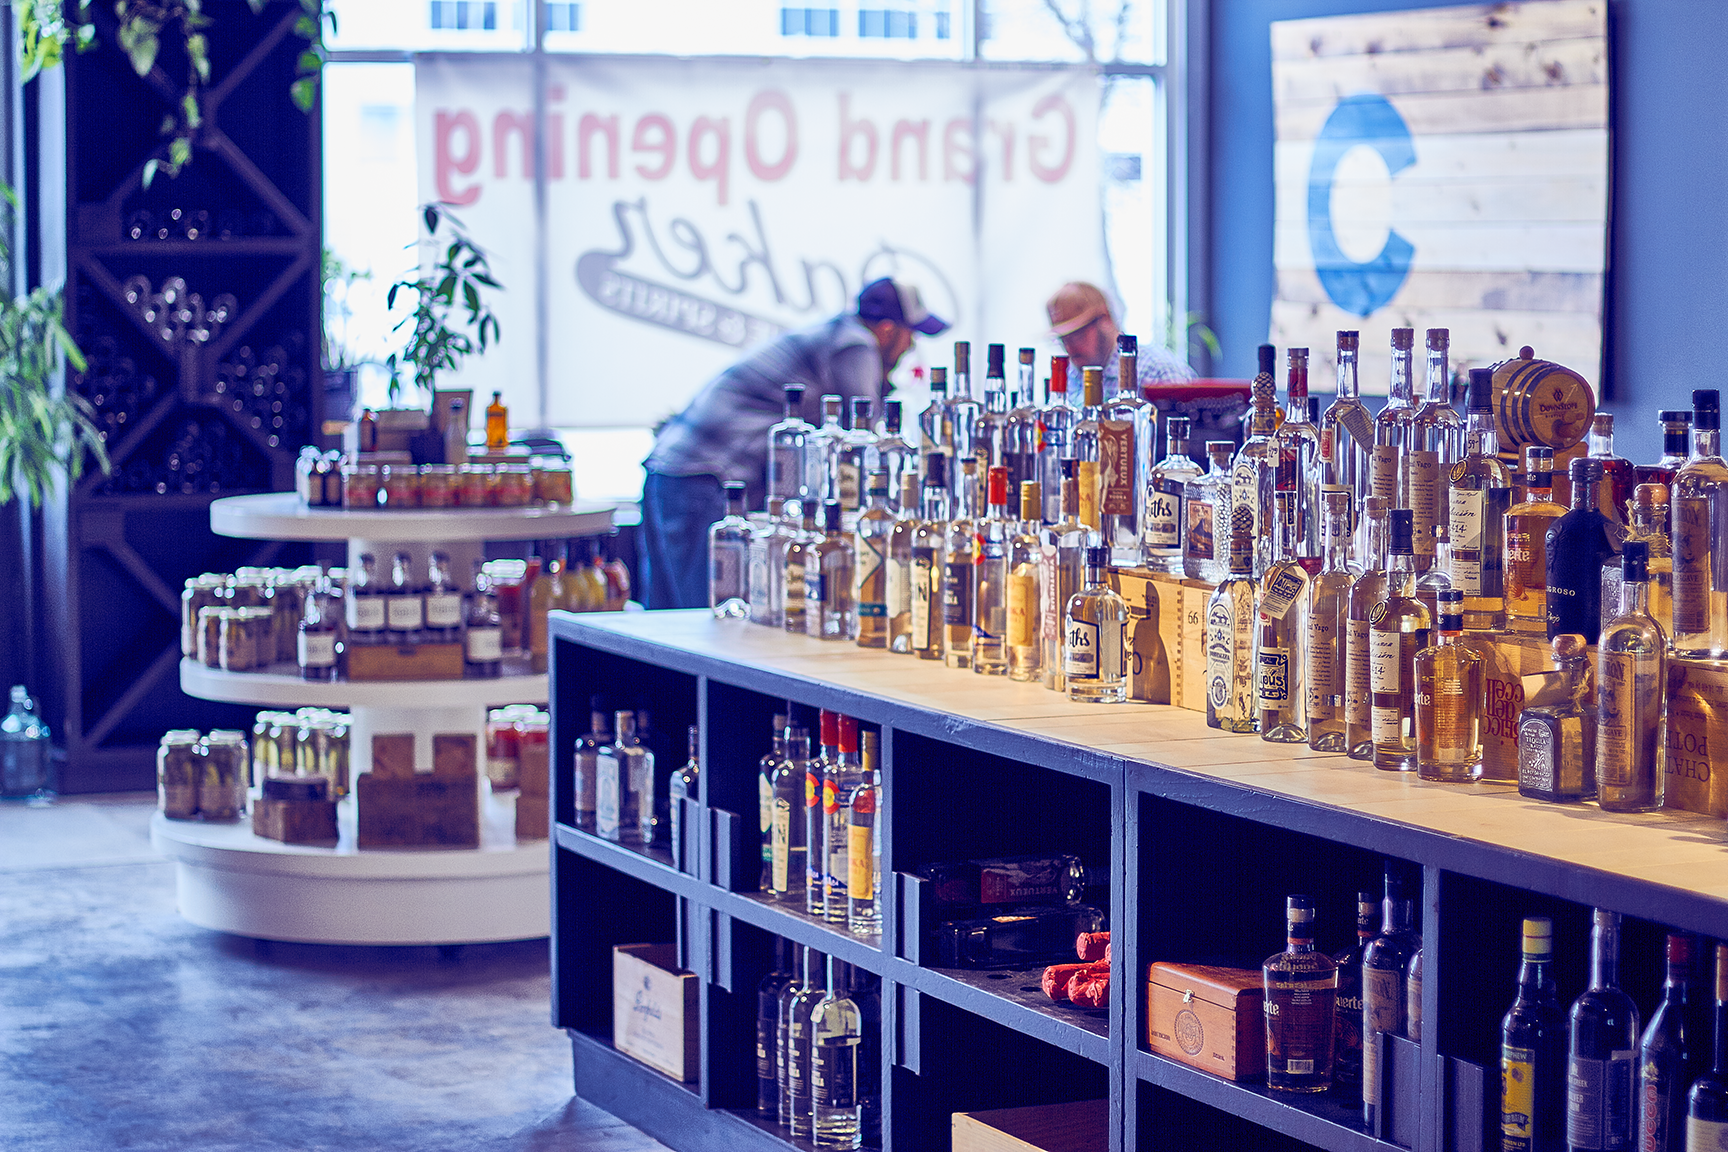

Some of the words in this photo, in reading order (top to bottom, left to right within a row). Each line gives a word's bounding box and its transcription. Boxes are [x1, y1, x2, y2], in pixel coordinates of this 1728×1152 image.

[1307, 91, 1418, 318] C
[1119, 433, 1128, 486] VERTUEUX
[1417, 461, 1432, 469] Vago
[1314, 624, 1329, 632] Vago
[1354, 630, 1369, 639] Vago
[1009, 887, 1059, 897] VERTUEUX
